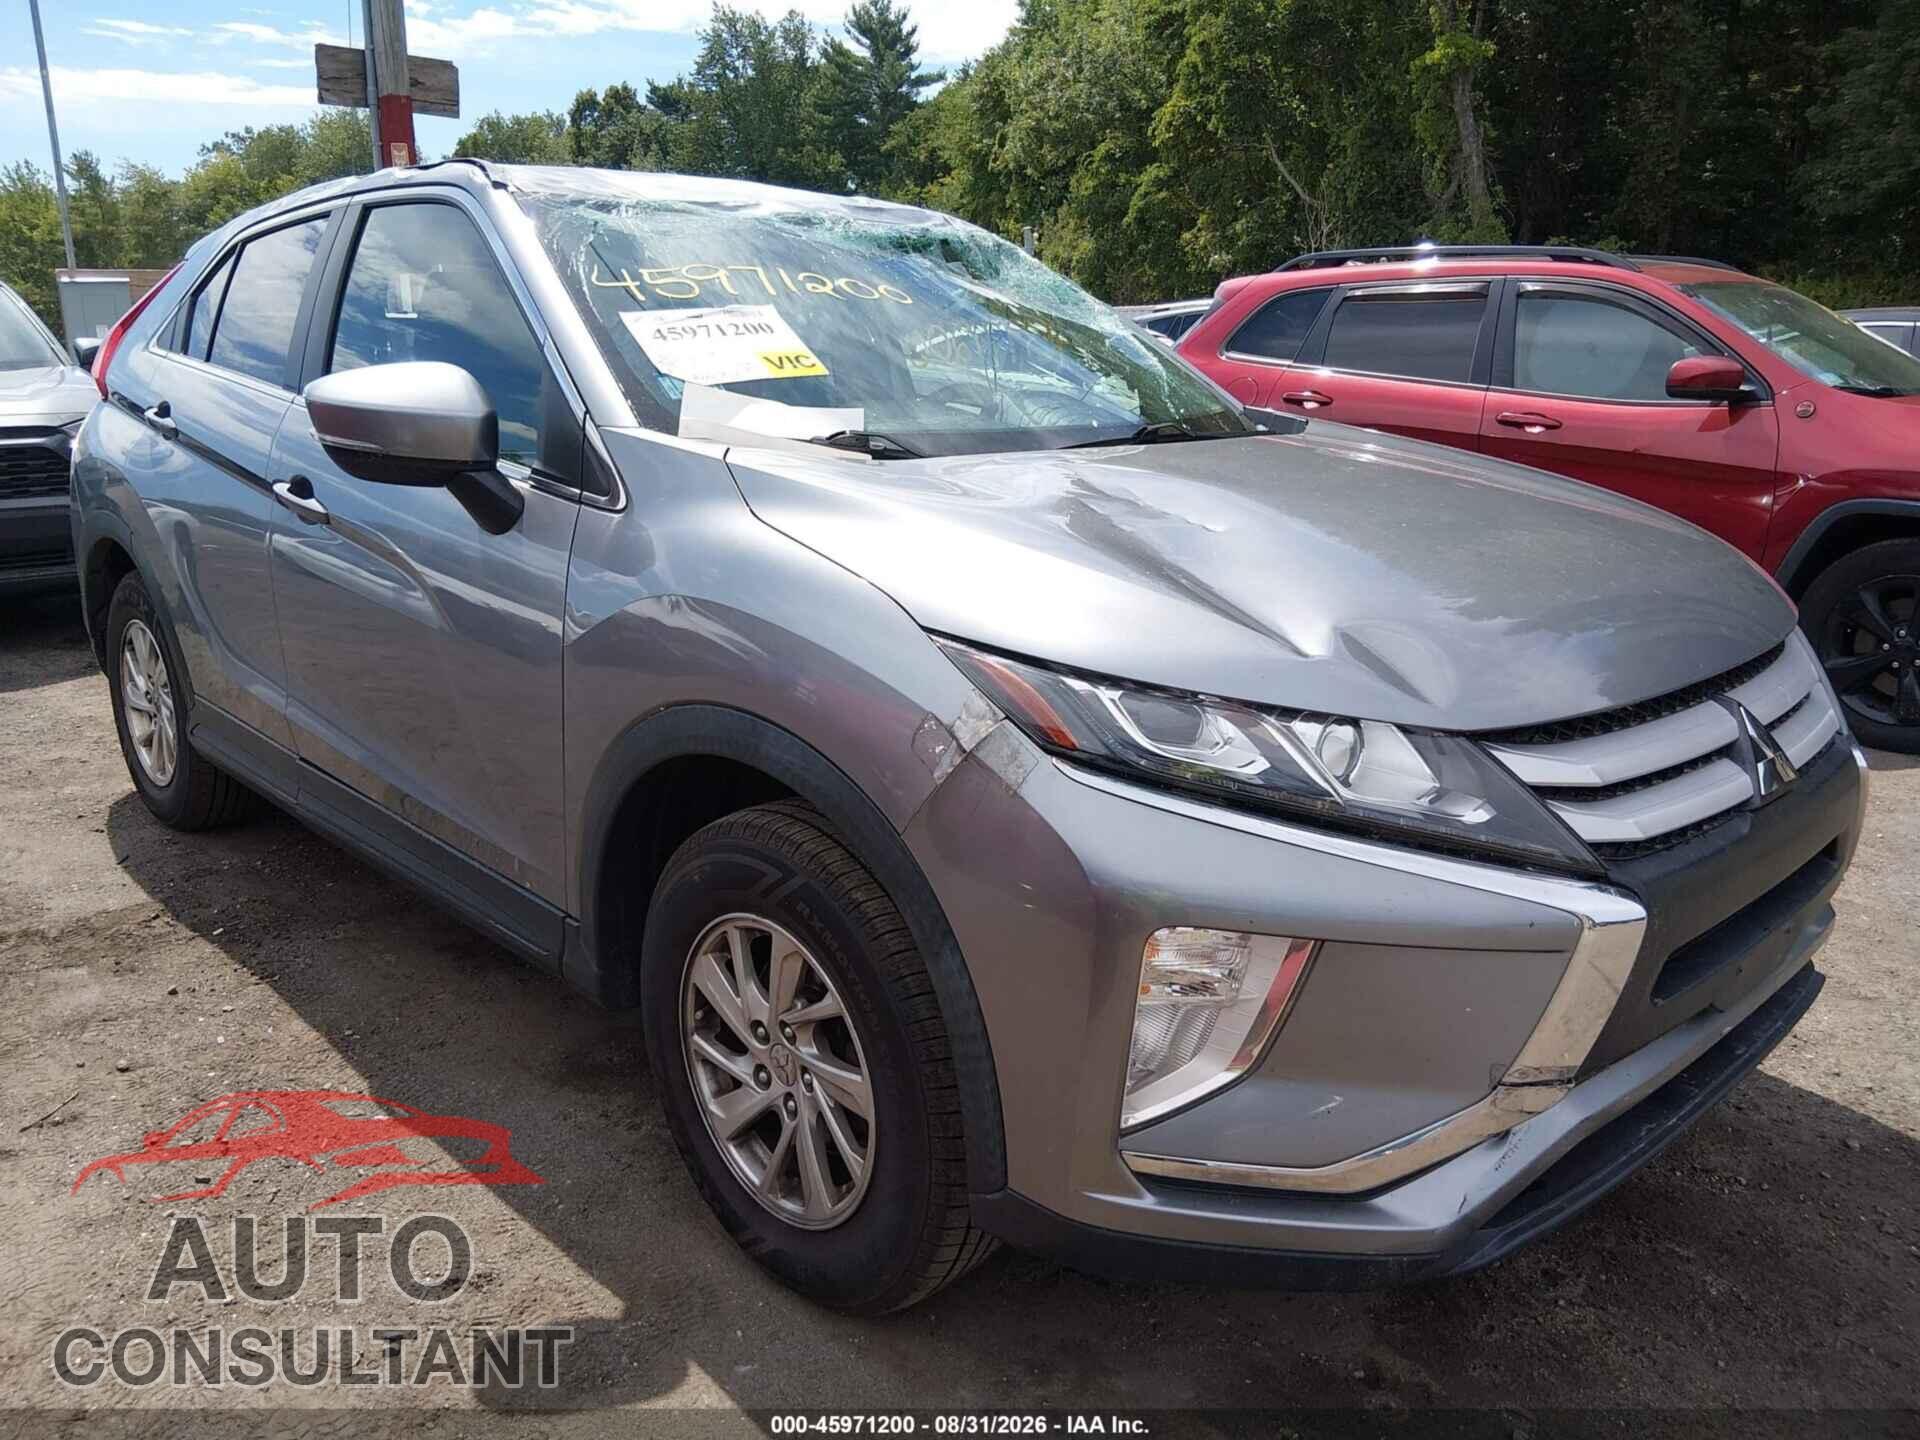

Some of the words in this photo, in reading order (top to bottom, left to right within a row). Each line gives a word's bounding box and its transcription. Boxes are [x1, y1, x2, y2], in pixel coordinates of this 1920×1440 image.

[591, 263, 914, 305] 45971200
[652, 321, 774, 342] 45971200
[762, 353, 818, 371] VIC
